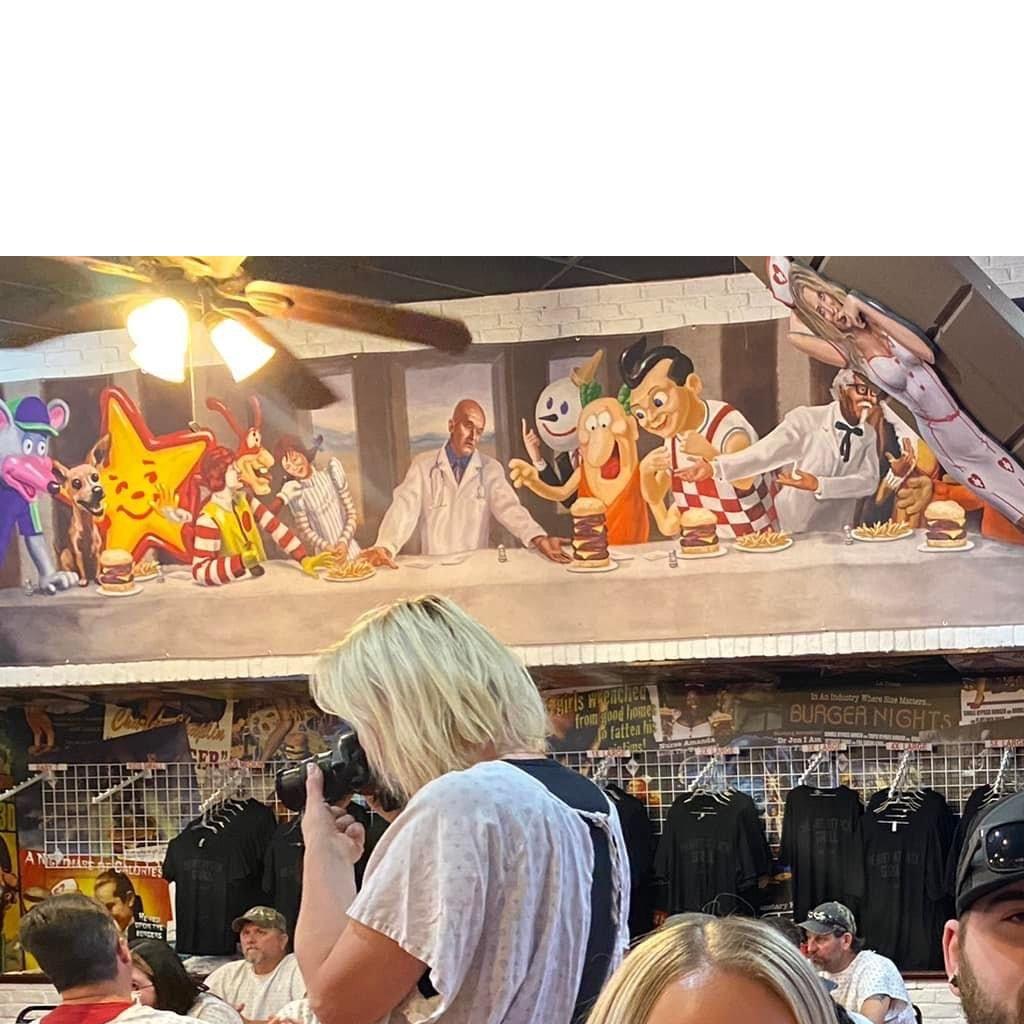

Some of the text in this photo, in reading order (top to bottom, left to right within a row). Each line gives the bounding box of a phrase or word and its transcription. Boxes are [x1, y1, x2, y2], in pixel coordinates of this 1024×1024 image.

[830, 693, 882, 703] Industry Where
[575, 706, 625, 728] from good
[790, 703, 867, 725] BURGER
[610, 722, 641, 739] fatten
[25, 851, 35, 865] A
